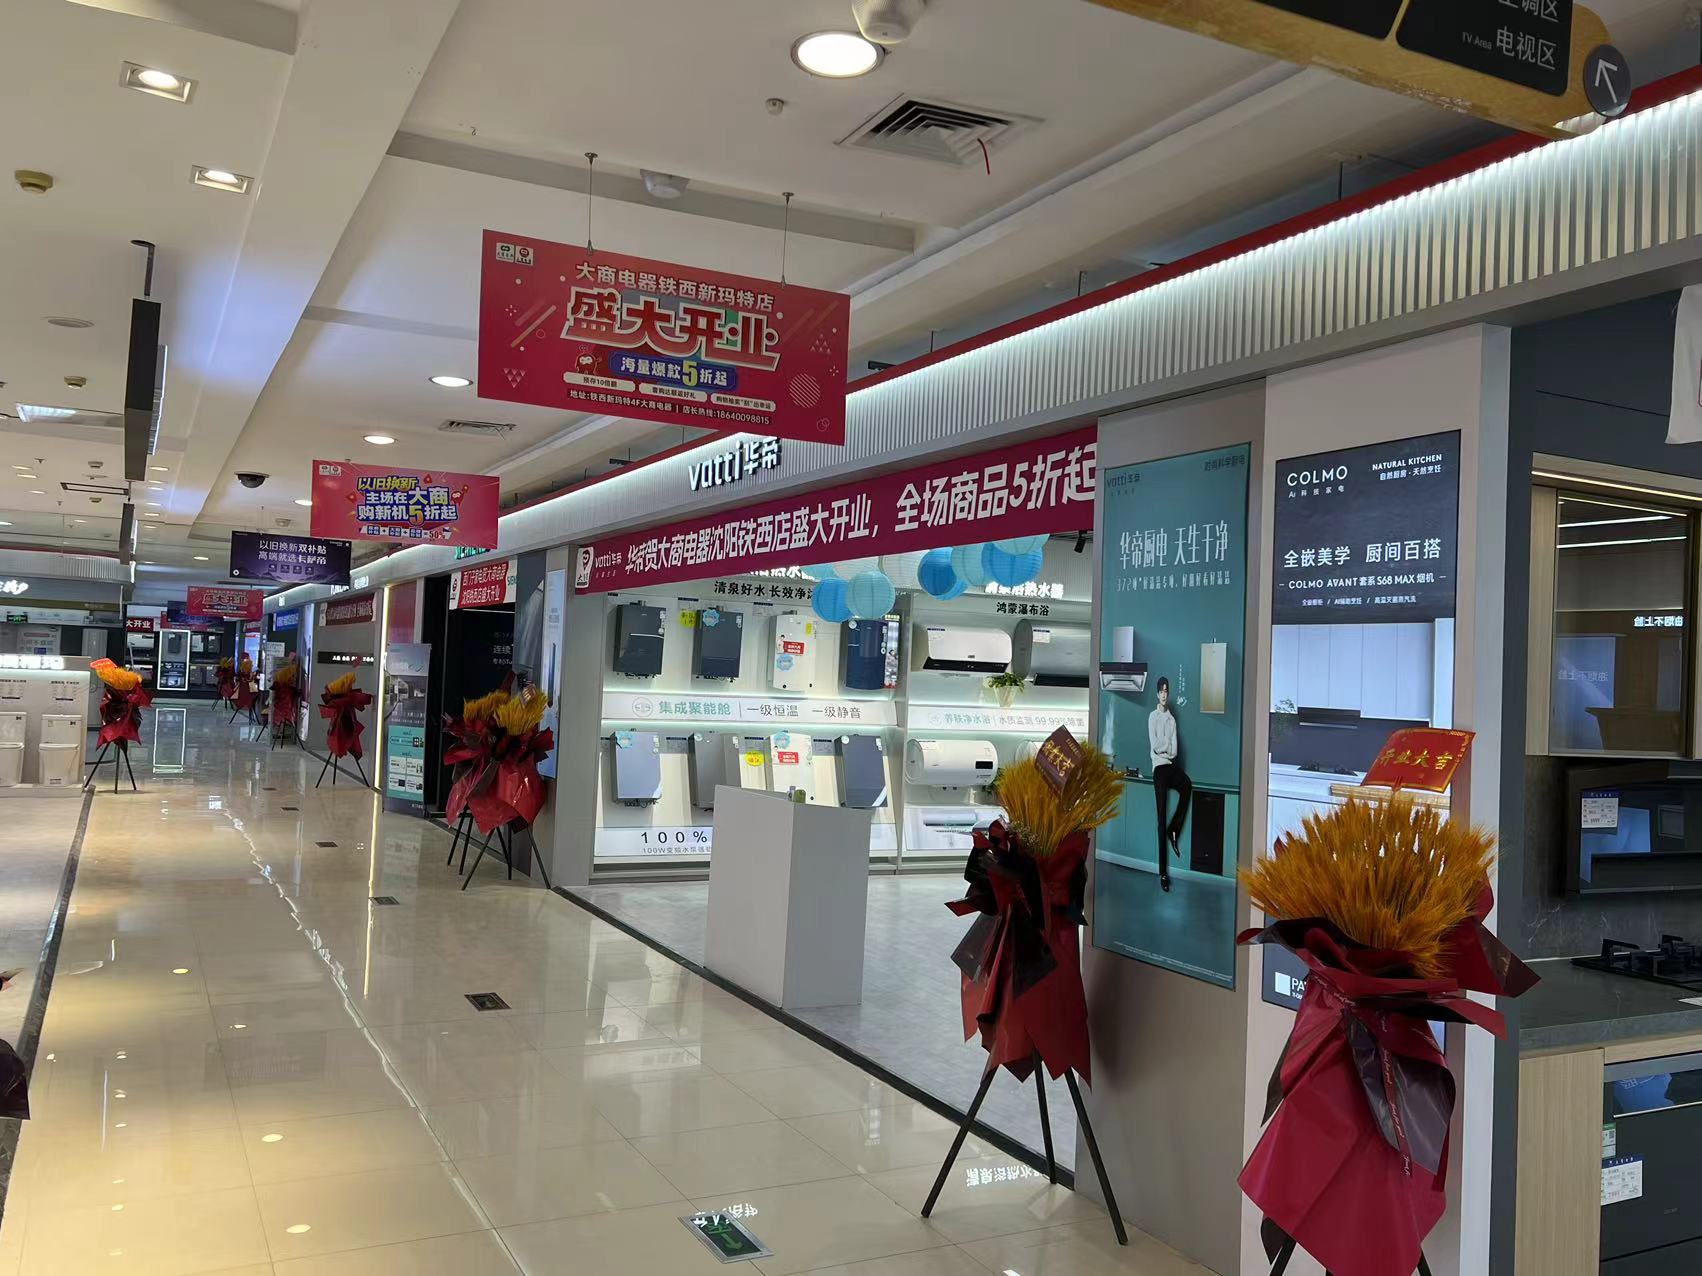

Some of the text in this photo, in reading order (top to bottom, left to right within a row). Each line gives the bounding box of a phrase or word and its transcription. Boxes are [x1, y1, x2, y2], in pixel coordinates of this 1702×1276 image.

[1462, 26, 1556, 70] TV Area 电视区
[576, 262, 774, 312] 大商电器铁西新玛特店
[560, 286, 781, 371] 盛大开业
[621, 356, 729, 387] 海量爆款5折起
[1372, 454, 1442, 471] NATURAL KITCHEN
[358, 476, 418, 491] 以旧换新
[1287, 465, 1348, 487] COLMO
[366, 487, 449, 505] 主场在大商
[358, 505, 458, 526] 购新机5折起
[259, 540, 327, 555] 以旧换新双补贴
[1120, 520, 1228, 570] 华帝厨电 天生干净
[1284, 538, 1442, 568] 全嵌美学 厨间百搭
[714, 580, 765, 597] 清泉好水
[1288, 580, 1324, 589] COLMO
[1327, 577, 1358, 588] AVANT
[1377, 575, 1393, 585] S68
[1395, 574, 1415, 585] MAX
[996, 601, 1050, 616] 鸿蒙瀑布浴
[126, 619, 151, 629] 大开业
[659, 700, 862, 719] 集成聚能舱 一级恒温 一级静音
[1378, 749, 1454, 770] 开业大吉
[641, 831, 708, 844] 100%
